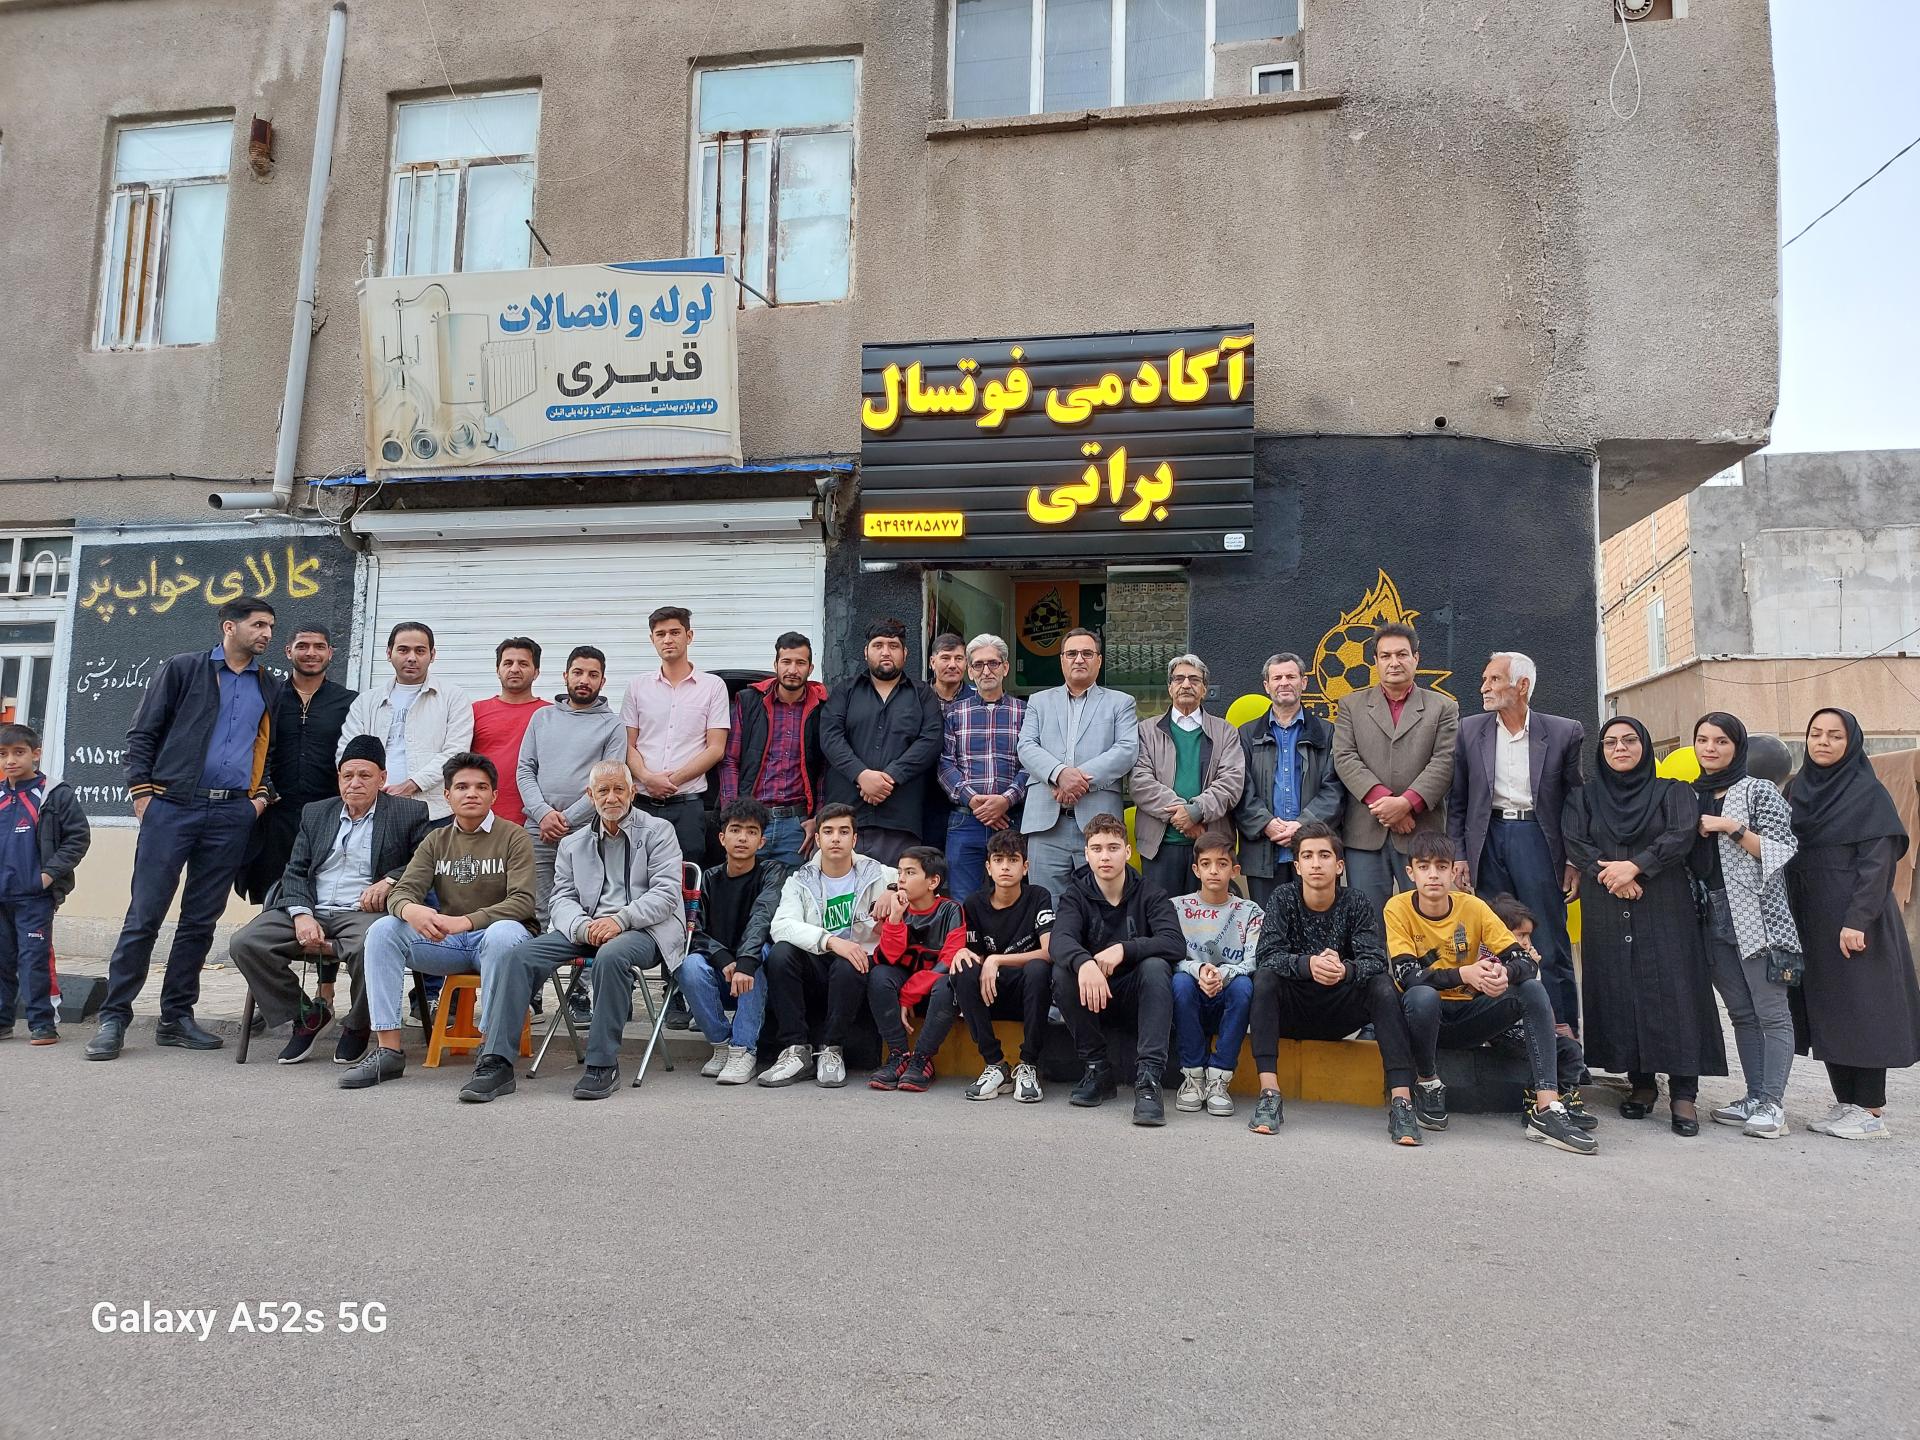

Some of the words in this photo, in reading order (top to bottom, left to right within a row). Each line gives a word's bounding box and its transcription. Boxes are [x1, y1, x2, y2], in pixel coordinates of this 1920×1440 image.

[499, 288, 619, 333] اتصالات
[624, 303, 644, 338] و
[650, 281, 714, 336] لوله
[557, 341, 703, 398] قنبری
[861, 345, 1032, 431] فوتسال
[1045, 334, 1254, 424] آکادمی
[1026, 441, 1175, 524] براتی
[870, 519, 959, 532] ۰۹۳۹۹۲۸۵۸۷۷
[114, 556, 201, 616] خواب
[205, 546, 321, 605] کالای
[1185, 907, 1220, 920] BACK
